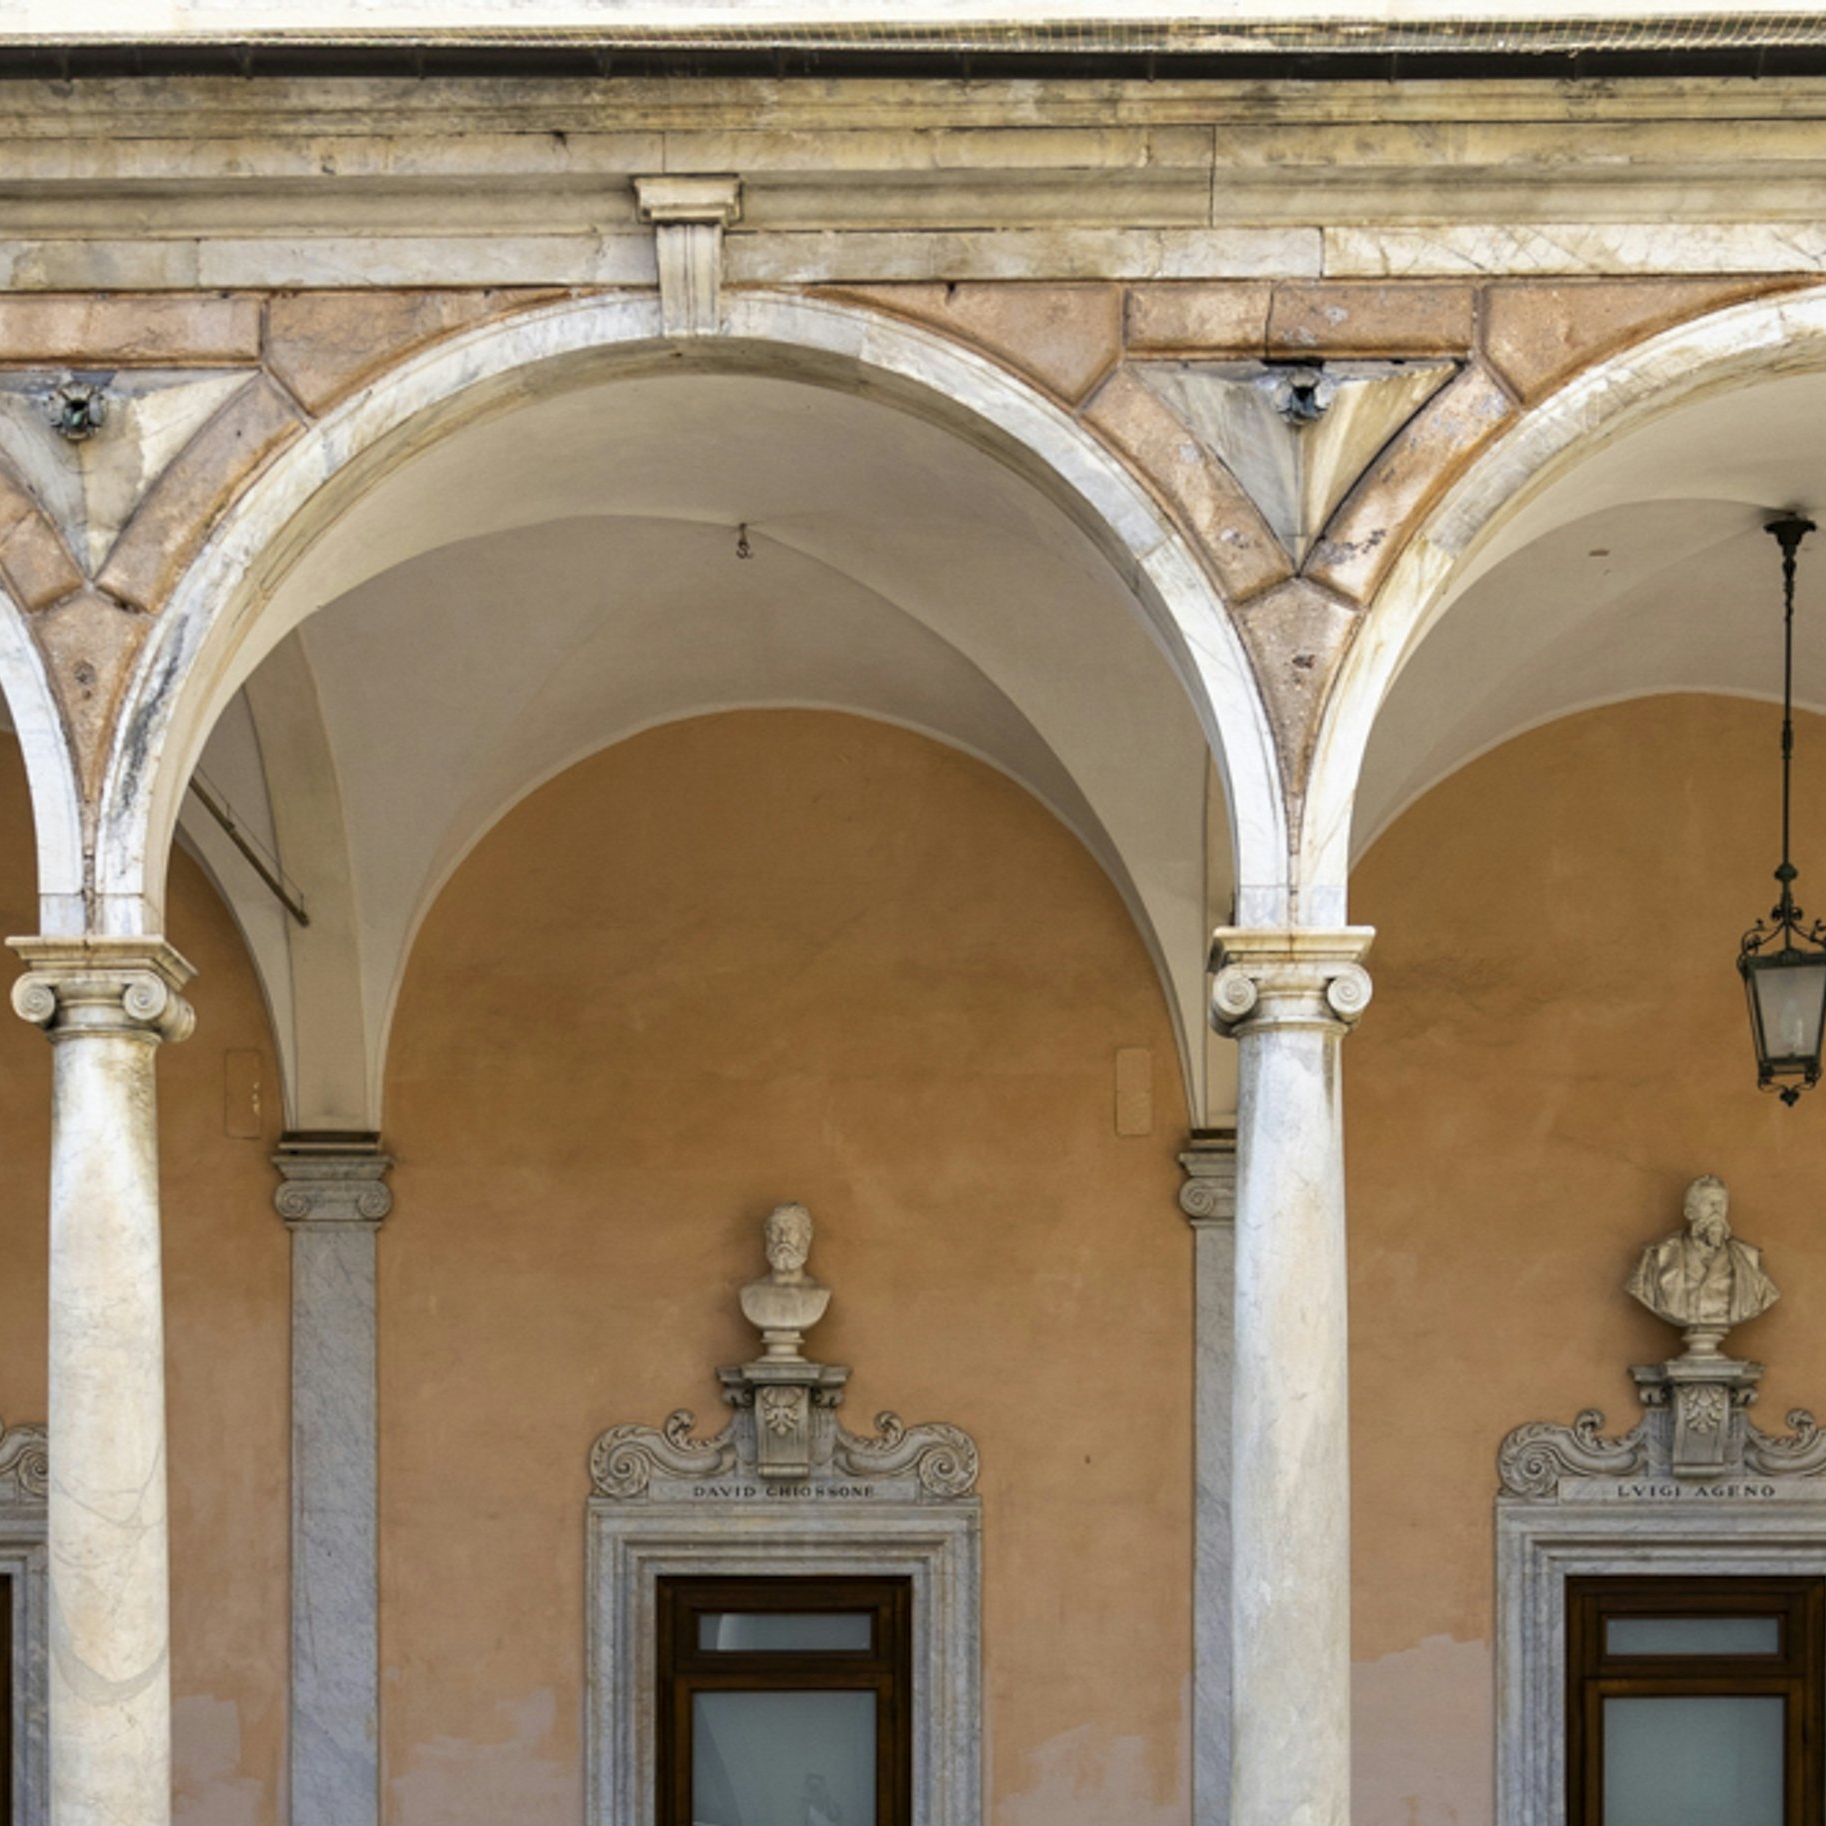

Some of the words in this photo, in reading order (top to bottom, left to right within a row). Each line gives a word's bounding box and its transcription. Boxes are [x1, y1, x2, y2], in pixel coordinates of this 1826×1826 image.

[693, 1485, 757, 1498] DAVID
[765, 1485, 875, 1498] CHIOSSONE
[1617, 1484, 1681, 1497] LVIGI
[1694, 1484, 1776, 1497] AGENO
